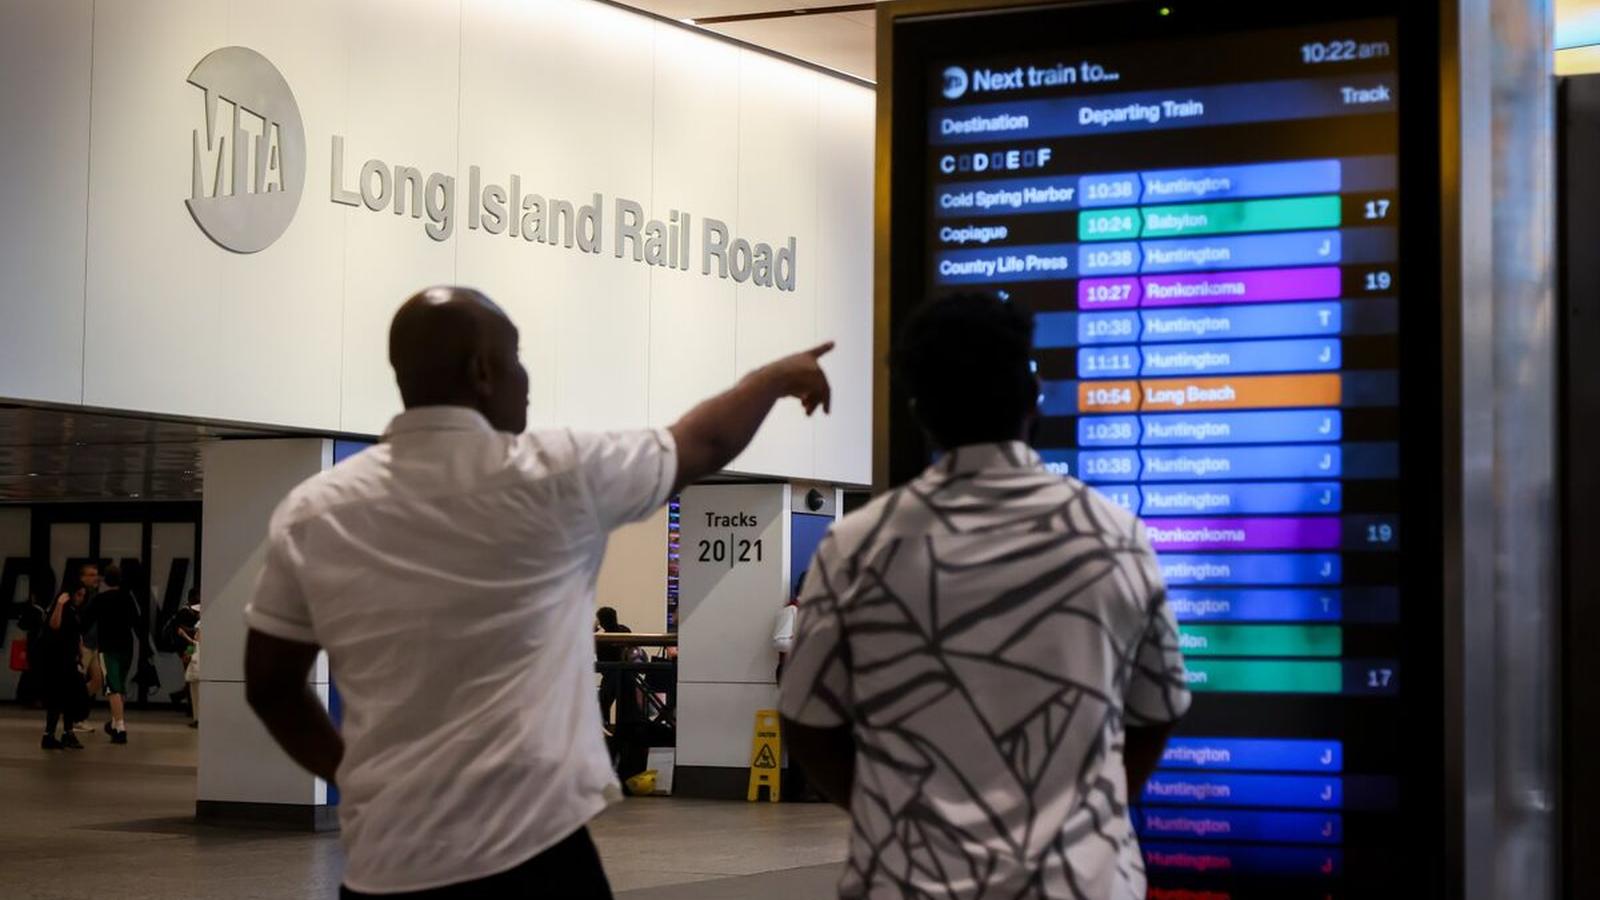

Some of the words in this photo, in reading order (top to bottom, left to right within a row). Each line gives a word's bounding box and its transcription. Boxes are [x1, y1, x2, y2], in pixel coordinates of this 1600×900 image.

[973, 68, 1024, 91] Next
[1028, 62, 1076, 86] train
[941, 114, 1029, 134] Destination
[1079, 104, 1161, 126] Departing
[1161, 100, 1204, 118] Train
[1341, 85, 1391, 104] Track
[940, 192, 973, 208] Cold
[975, 188, 1022, 208] Spring
[1023, 185, 1075, 204] Harbor
[1087, 182, 1132, 199] 10:38
[1148, 178, 1230, 196] Huntington
[330, 134, 455, 241] Long
[468, 165, 603, 254] Island
[615, 197, 691, 271] Rail
[702, 217, 797, 292] Road
[940, 225, 1008, 243] Copiague
[1087, 216, 1132, 234] 10:24
[1147, 213, 1207, 231] Babylon
[1365, 199, 1390, 219] 17
[940, 259, 996, 277] Country
[997, 255, 1025, 273] Life
[1025, 254, 1068, 271] Press
[1087, 251, 1132, 268] 10:38
[1148, 247, 1230, 265] Huntington
[1318, 239, 1331, 256] J
[1087, 284, 1132, 302] 10:27
[1147, 281, 1246, 299] Ronkonkoma
[1365, 271, 1392, 291] 19
[1148, 316, 1230, 335] Huntington
[1318, 310, 1331, 327] T
[1087, 354, 1131, 371] 11:11
[1148, 351, 1230, 370] Huntington
[1318, 347, 1331, 363] J
[1087, 388, 1132, 405] 10:54
[1148, 386, 1185, 406] Long
[1186, 384, 1236, 401] Beach
[1148, 420, 1230, 440] Huntington
[1318, 417, 1331, 434] J
[1148, 456, 1230, 476] Huntington
[1318, 453, 1331, 470] J
[1148, 491, 1230, 511] Huntington
[1318, 490, 1331, 506] J
[705, 511, 758, 528] Tracks
[1147, 527, 1246, 542] Ronkonkoma
[1367, 524, 1392, 543] 19
[1163, 562, 1230, 580] untington
[1318, 562, 1331, 578] J
[1367, 669, 1393, 687] 17
[1320, 748, 1332, 765] J
[1147, 781, 1230, 800] Huntington
[1320, 784, 1332, 801] J
[1147, 815, 1231, 835] Huntington
[1320, 820, 1332, 837] J
